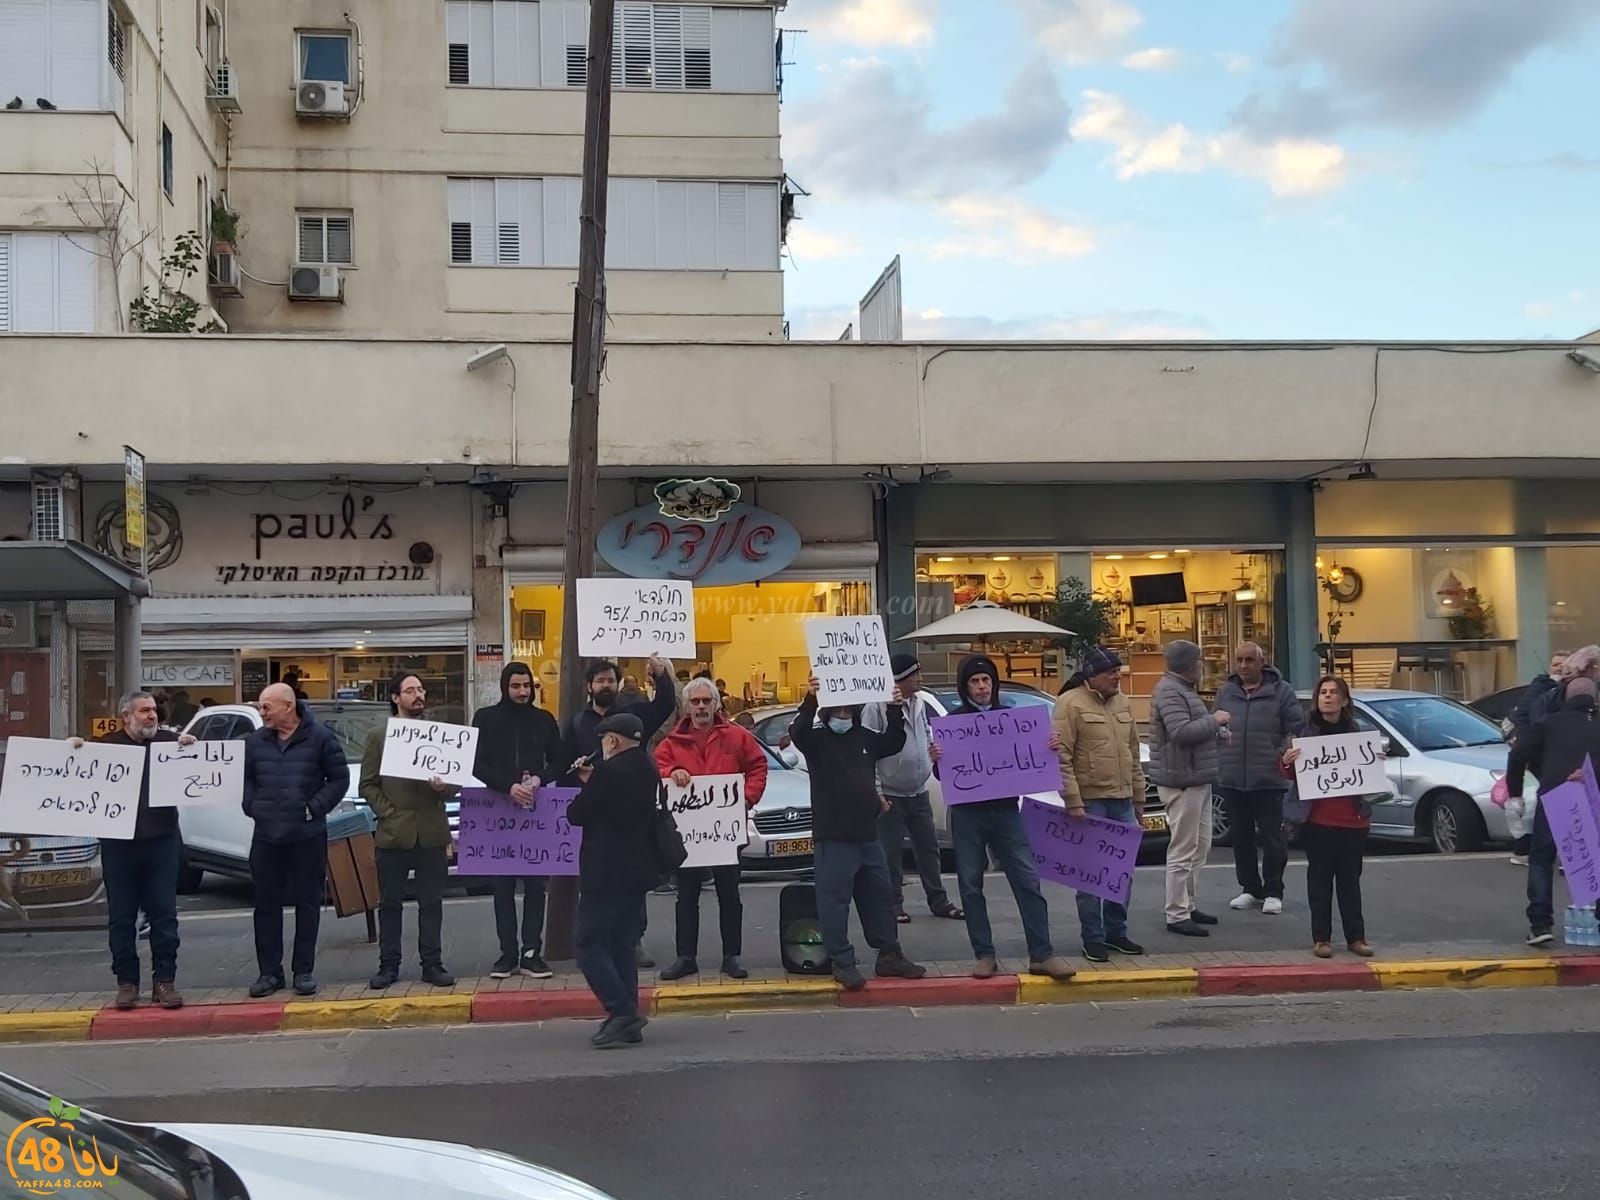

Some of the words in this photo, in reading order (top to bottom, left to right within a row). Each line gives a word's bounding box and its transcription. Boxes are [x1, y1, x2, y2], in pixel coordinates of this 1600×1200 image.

[256, 494, 393, 559] paul's
[217, 563, 299, 584] האיטלקי
[311, 564, 365, 584] הקפה
[376, 562, 425, 581] מרכז
[633, 609, 687, 623] הבטחת
[652, 630, 686, 643] הנחה
[864, 621, 880, 647] לא
[183, 666, 233, 681] CAFE
[97, 719, 118, 732] 46
[935, 714, 986, 741] למכירה
[988, 712, 1010, 736] לא
[1013, 718, 1038, 734] יפו
[441, 730, 471, 749] לא
[157, 746, 198, 763] مش
[205, 742, 234, 765] يافا
[412, 745, 461, 775] הנישול
[1013, 743, 1047, 774] يافا
[1297, 745, 1347, 773] للتطهير
[1357, 741, 1376, 766] لا
[20, 756, 74, 777] למכירה
[75, 759, 98, 779] לא
[105, 762, 130, 782] יפו
[951, 751, 984, 791] للبيع
[184, 772, 222, 798] للبيع
[1317, 767, 1364, 794] العرقي
[38, 791, 100, 814] ליפואים
[717, 780, 739, 808] لا
[104, 802, 126, 819] יפו
[723, 820, 740, 842] לא
